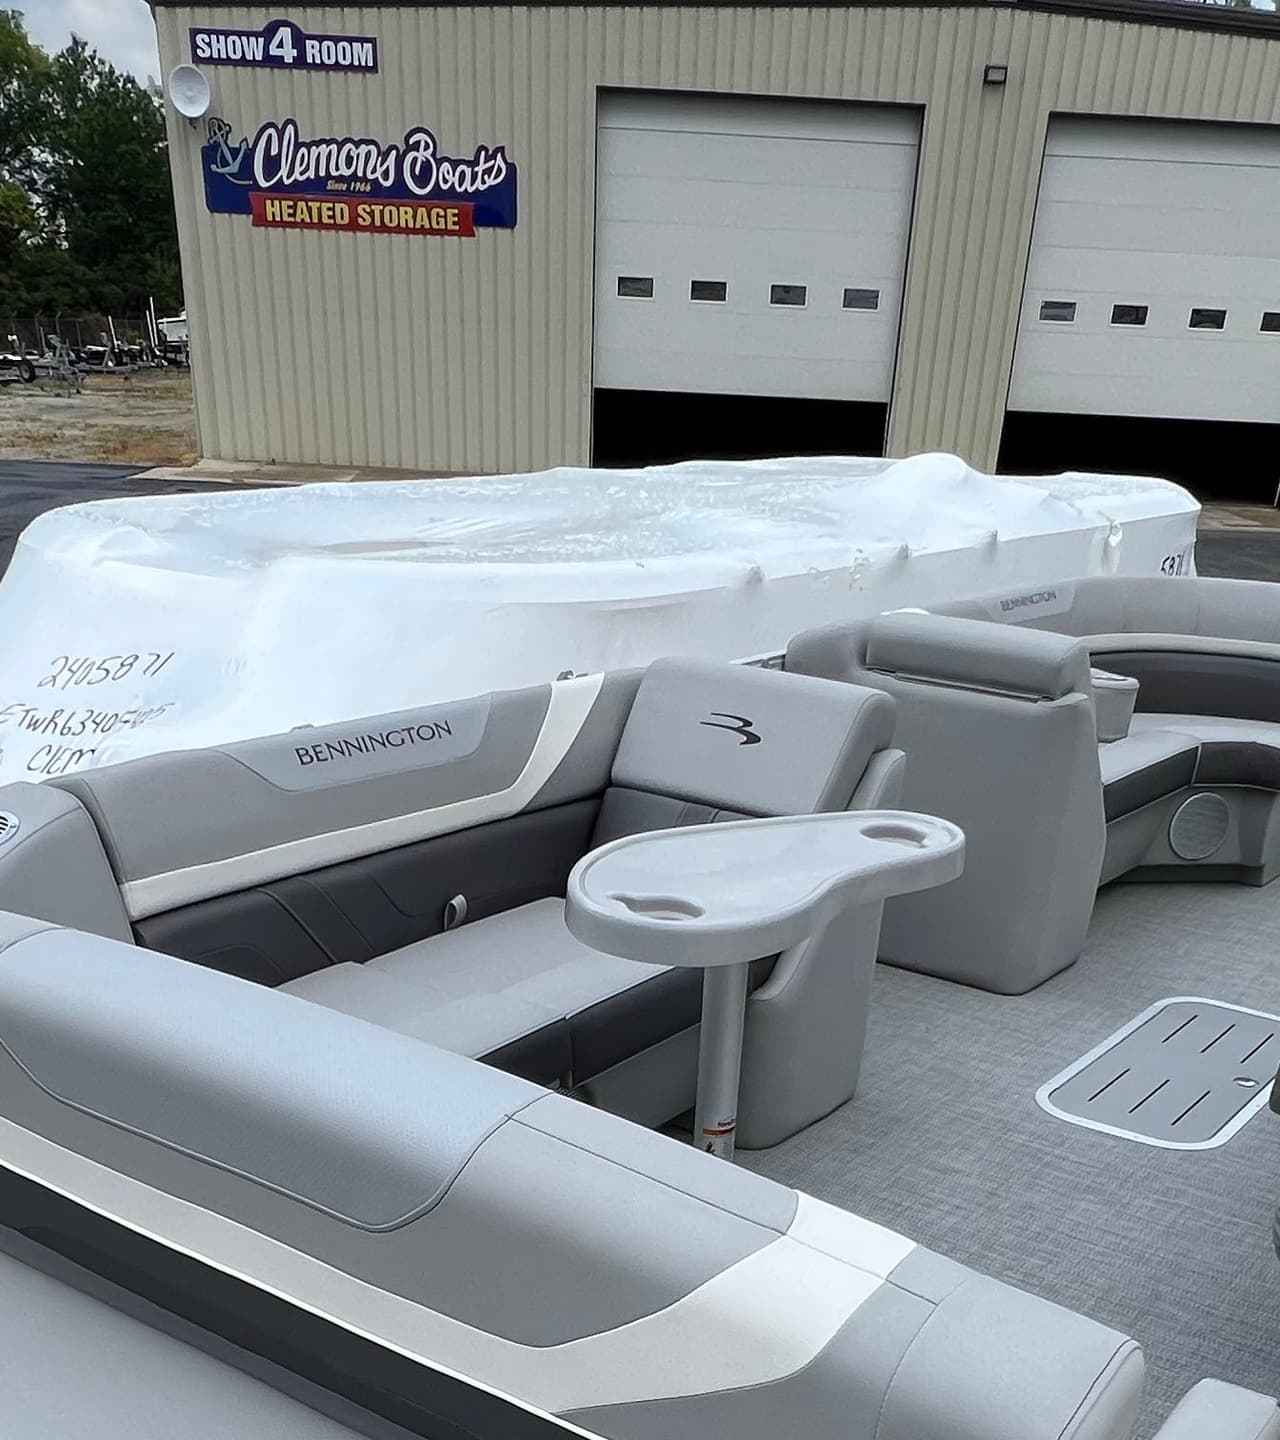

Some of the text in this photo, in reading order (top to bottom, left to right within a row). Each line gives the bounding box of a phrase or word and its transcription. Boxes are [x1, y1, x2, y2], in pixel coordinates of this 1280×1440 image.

[195, 26, 374, 66] SHOW 4 ROOM
[253, 123, 507, 195] Clemons Boats
[265, 199, 460, 231] HEATED STORAGE
[295, 720, 453, 766] BENNINGTON
